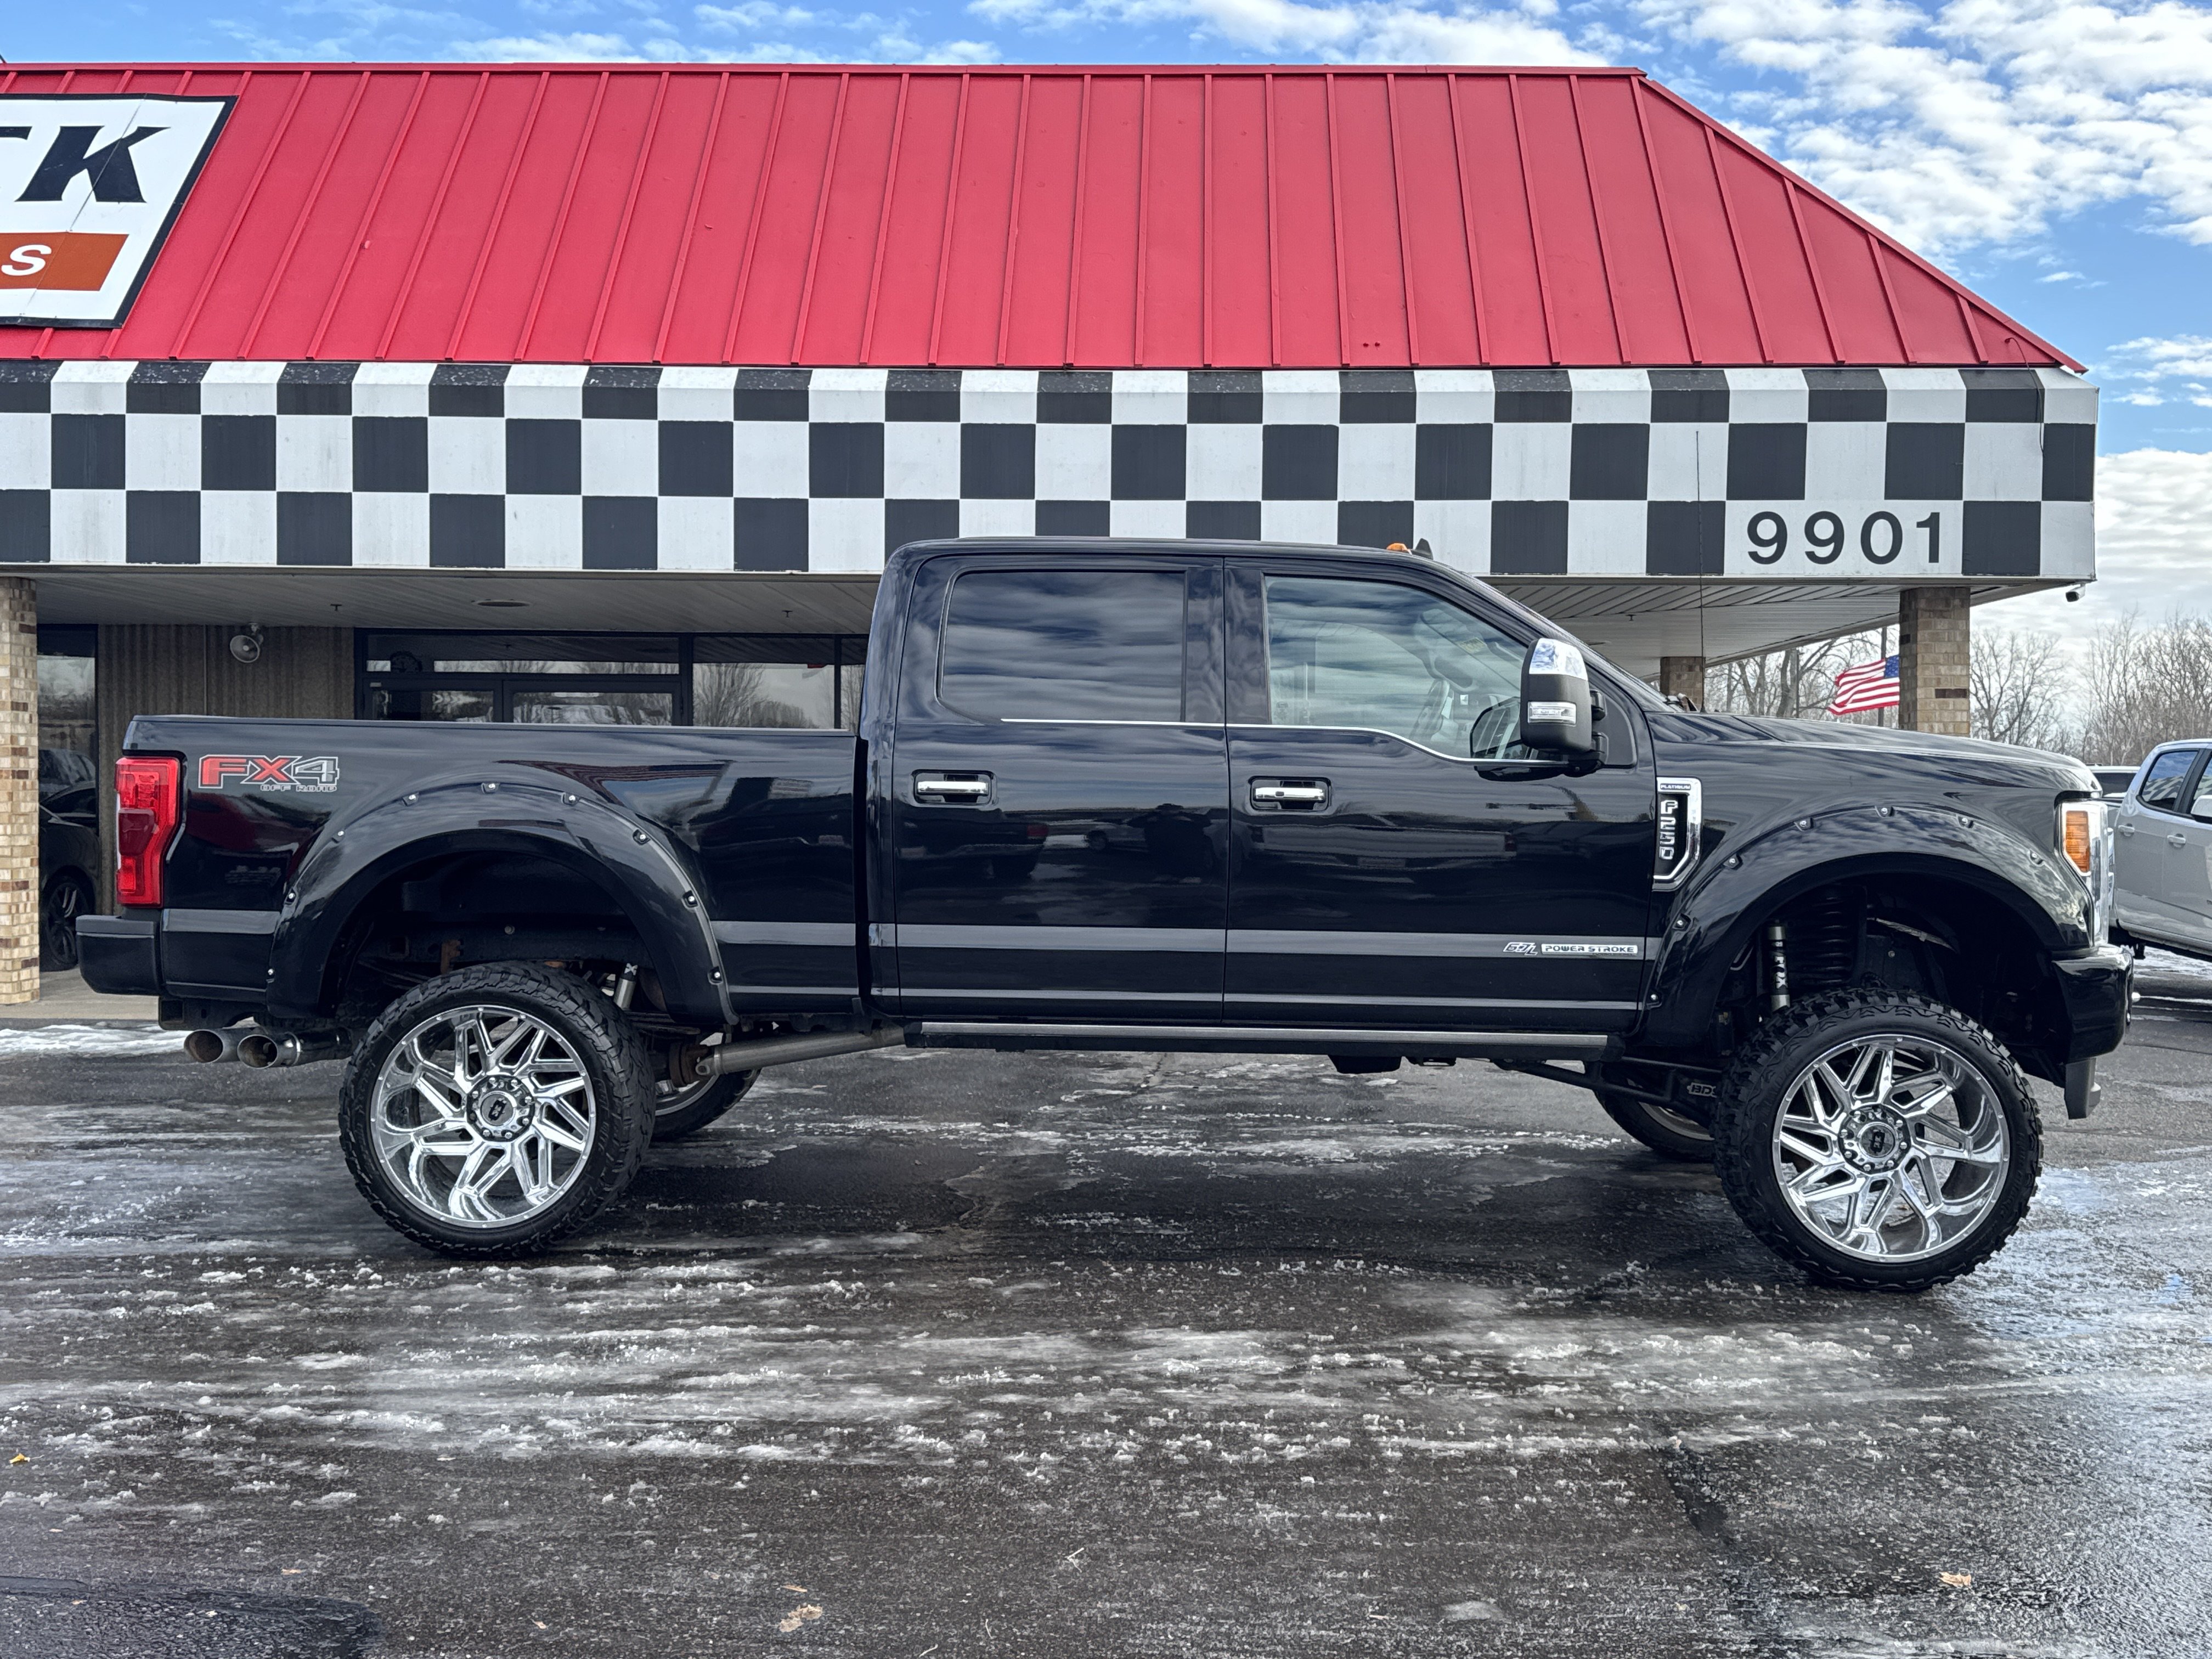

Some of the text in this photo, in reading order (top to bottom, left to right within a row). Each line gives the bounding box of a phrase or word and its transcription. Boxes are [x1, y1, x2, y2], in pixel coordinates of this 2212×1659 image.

[0, 126, 171, 204] K
[1747, 511, 1940, 565] 9901
[199, 754, 340, 789] FX4
